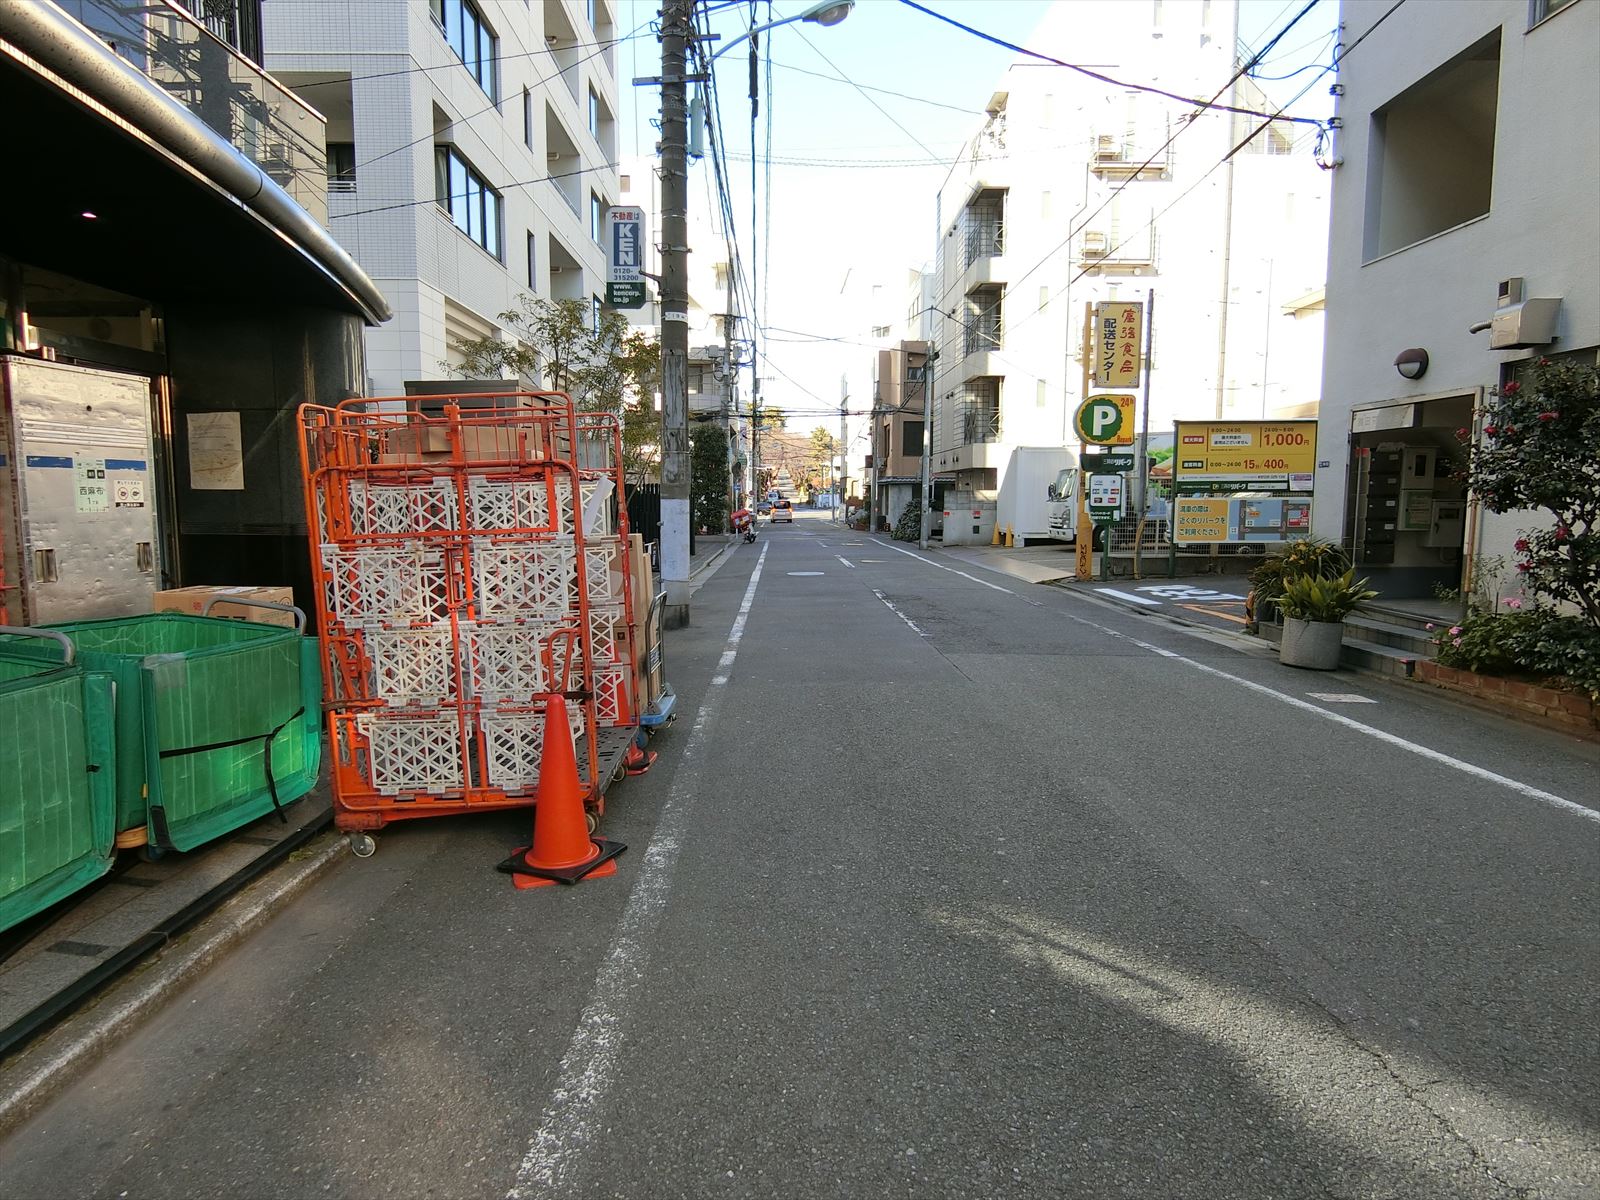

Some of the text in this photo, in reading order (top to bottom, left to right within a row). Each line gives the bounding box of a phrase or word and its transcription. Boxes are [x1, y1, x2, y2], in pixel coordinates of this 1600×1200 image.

[611, 212, 639, 220] 不動産は
[619, 223, 634, 265] KEN
[1103, 317, 1117, 381] 配送センター
[1093, 405, 1117, 436] P
[79, 486, 103, 495] 西麻布
